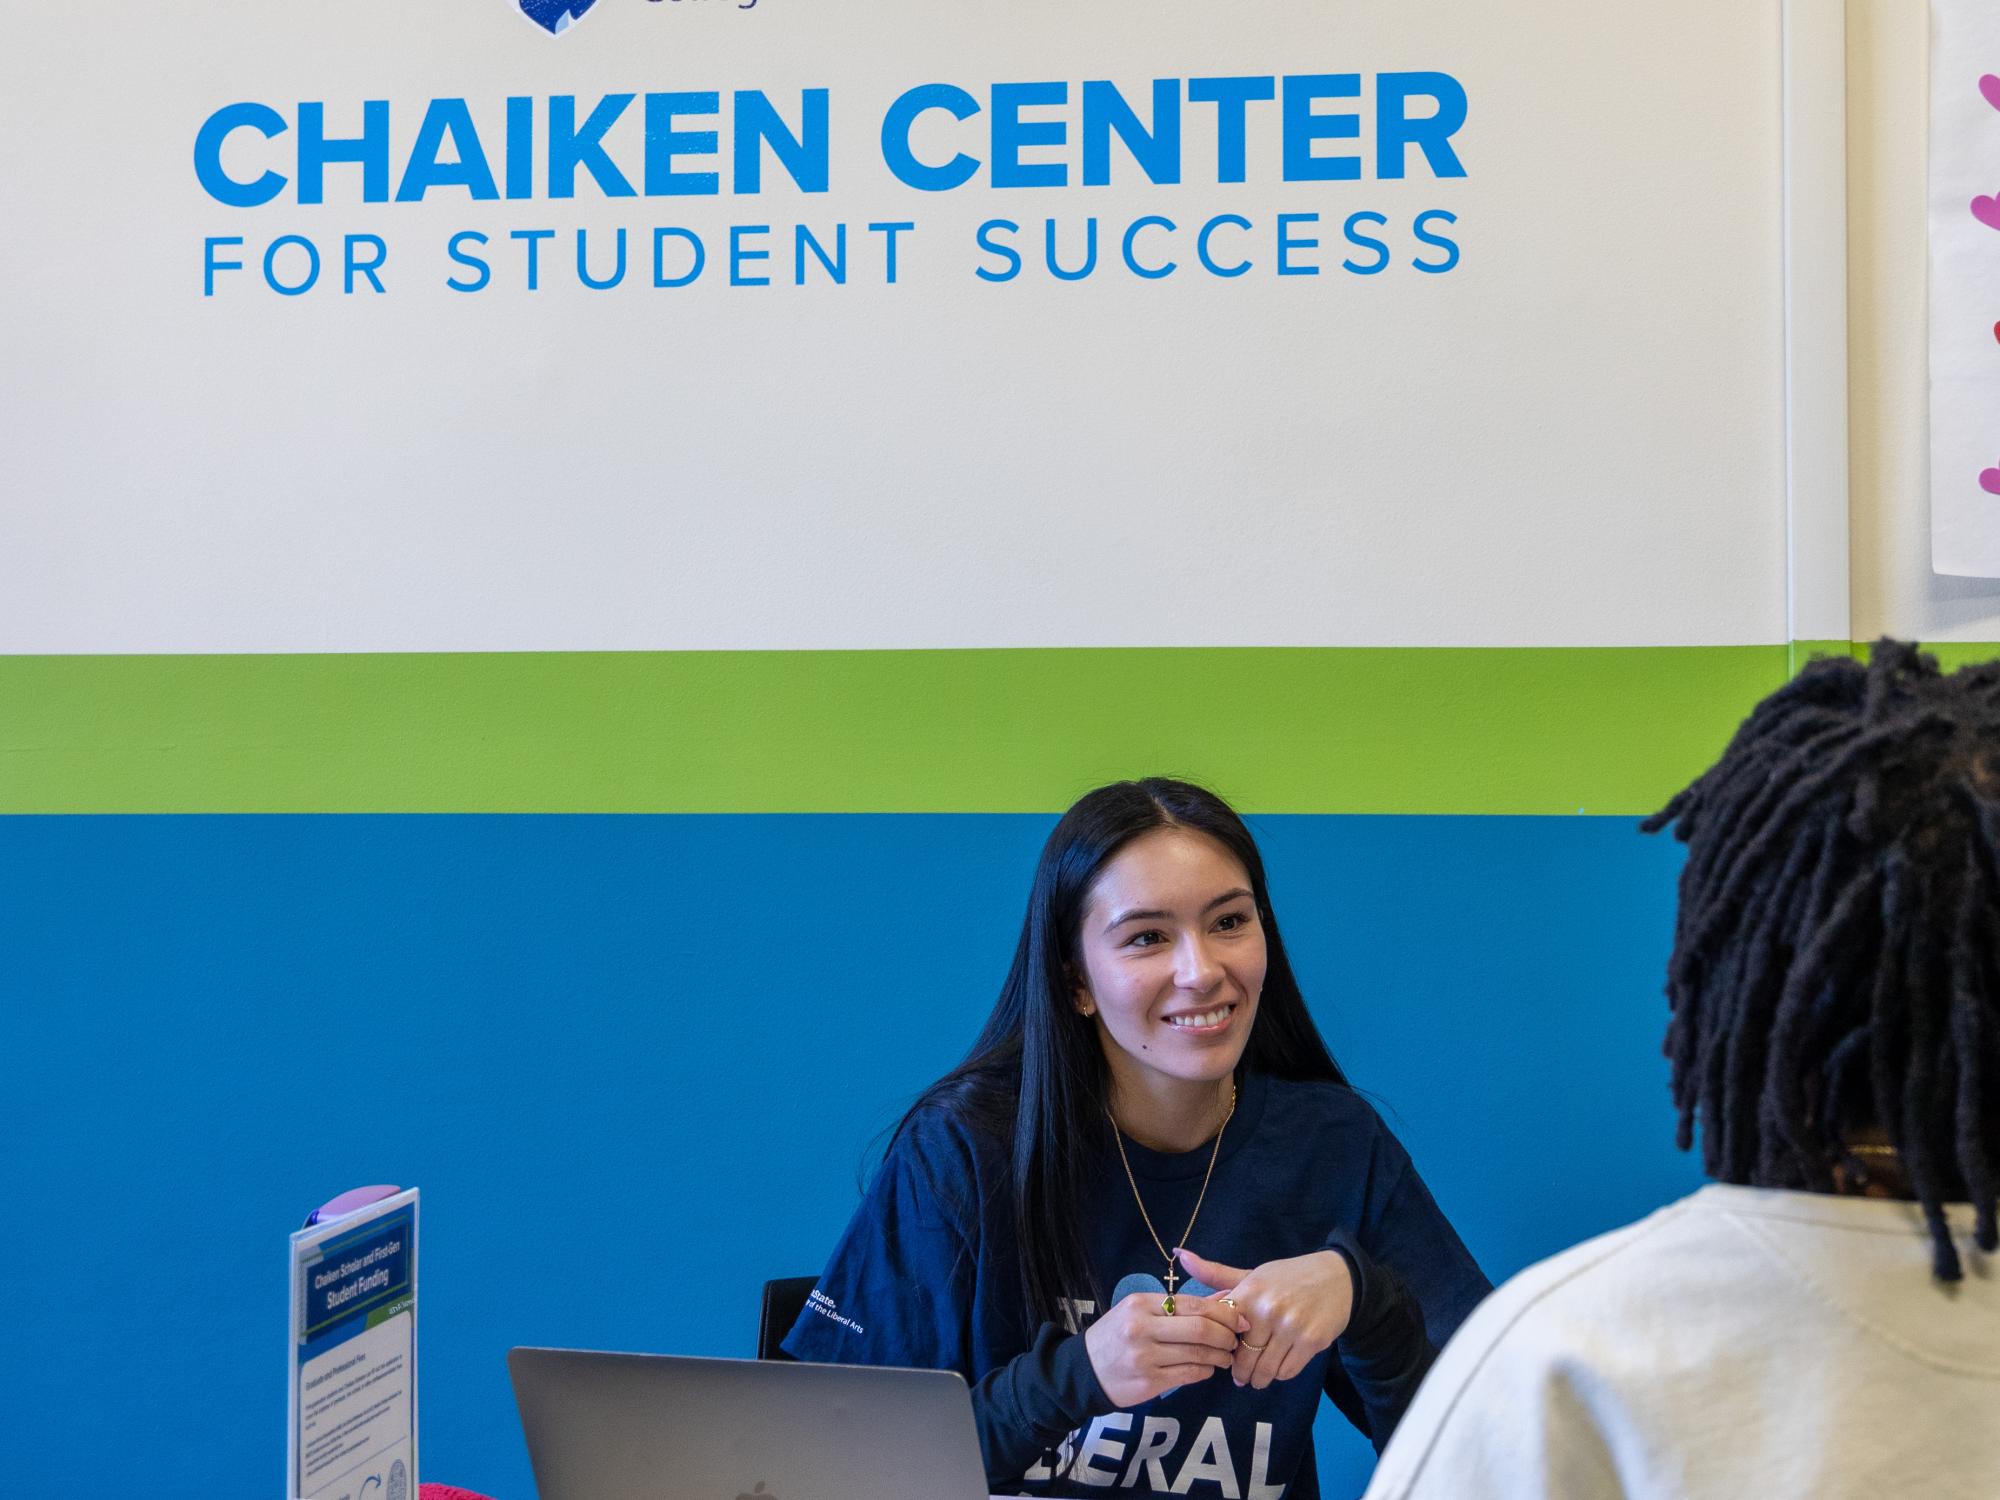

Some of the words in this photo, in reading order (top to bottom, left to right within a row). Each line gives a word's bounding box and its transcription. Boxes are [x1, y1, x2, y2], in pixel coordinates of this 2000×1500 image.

[193, 87, 829, 208] CHAIKEN
[881, 71, 1467, 192] CENTER
[204, 233, 387, 297] FOR
[447, 222, 915, 293] STUDENT
[976, 209, 1460, 283] SUCCESS
[315, 1269, 340, 1289] Chaiken
[340, 1258, 361, 1278] Scholar
[362, 1250, 374, 1267] and
[375, 1241, 400, 1261] First-Gen
[327, 1281, 357, 1310] Student
[358, 1269, 389, 1294] Funding
[815, 1304, 827, 1315] the
[827, 1309, 851, 1326] Liberal
[849, 1321, 864, 1334] Arts
